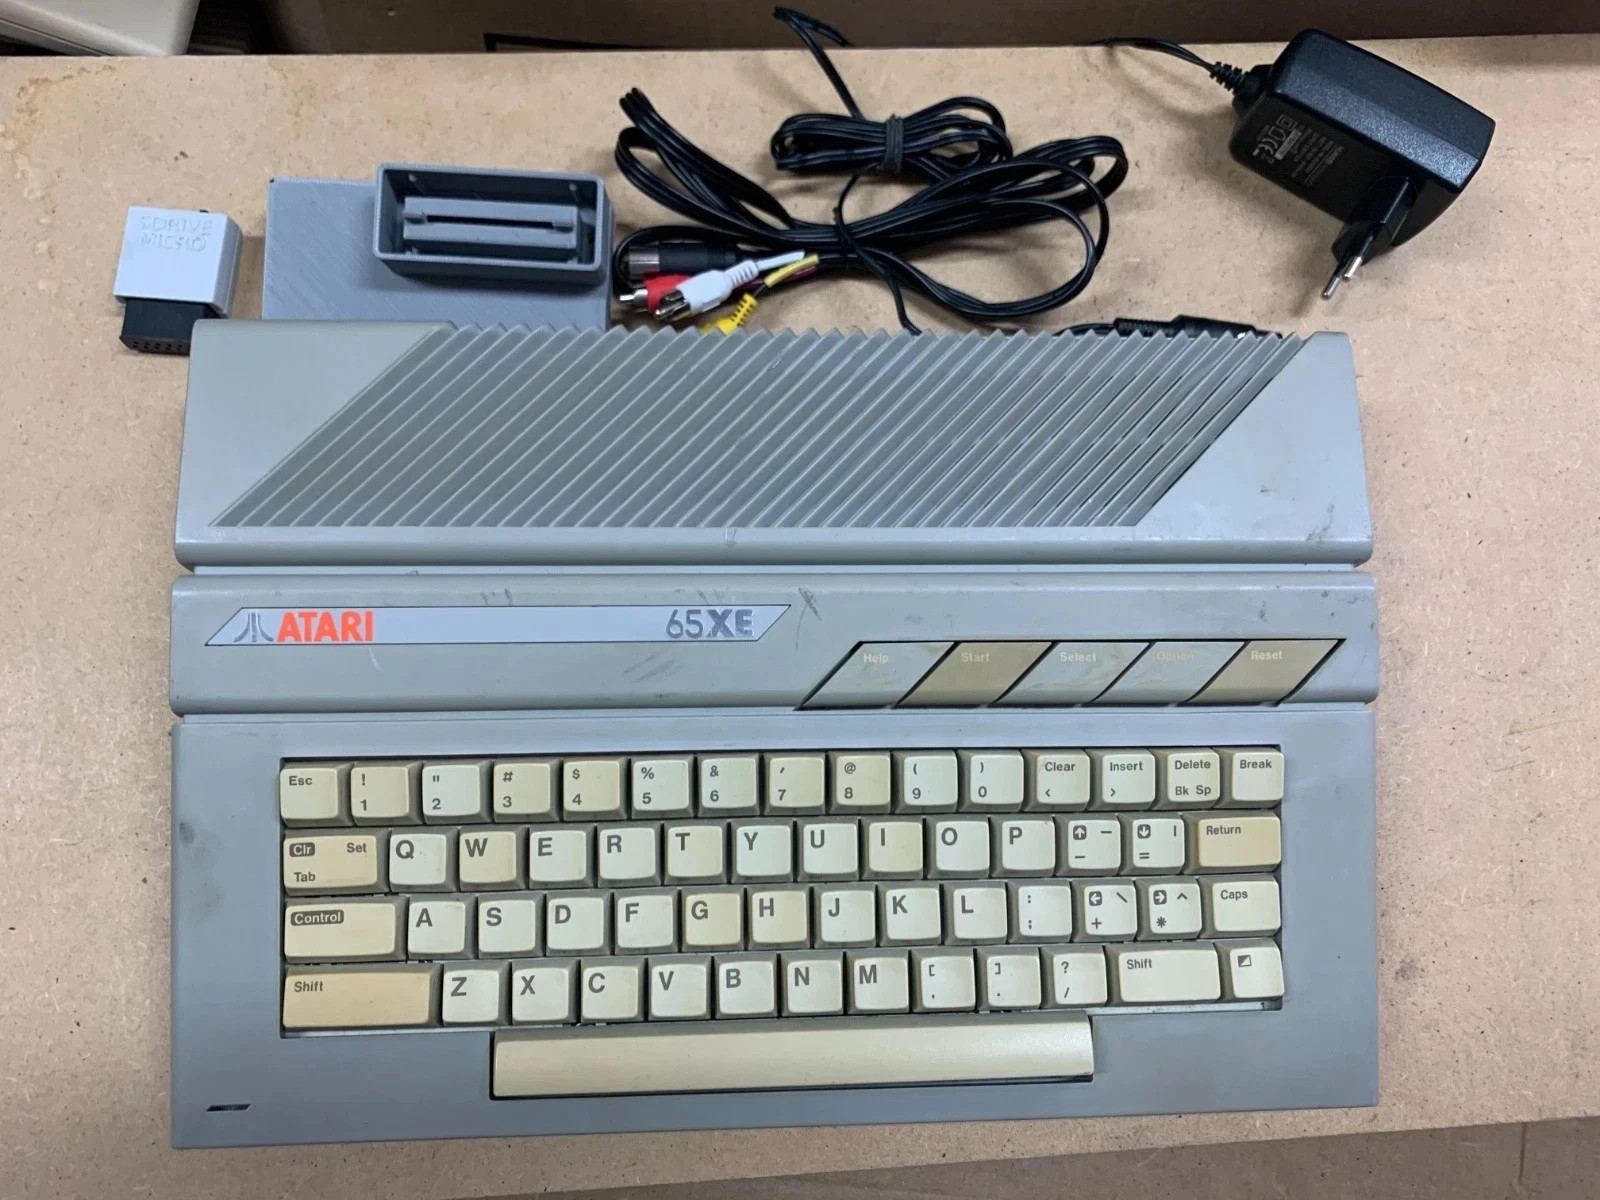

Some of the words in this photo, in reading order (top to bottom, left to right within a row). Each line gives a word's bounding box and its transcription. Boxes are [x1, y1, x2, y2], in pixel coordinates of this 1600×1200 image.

[276, 611, 373, 642] ATARI
[666, 609, 753, 639] 65XE
[864, 653, 889, 664] Help
[961, 652, 990, 662] Start
[1060, 652, 1096, 662] Select
[1251, 650, 1282, 660] Reset
[844, 762, 856, 774] @
[1045, 762, 1075, 771] Clear
[1110, 761, 1143, 771] Insert
[1175, 760, 1211, 769] Delete
[1240, 759, 1272, 769] Break
[503, 772, 513, 782] #
[573, 769, 580, 780] $
[641, 767, 654, 779] %
[710, 765, 718, 777] &
[289, 776, 312, 785] Esc
[361, 773, 366, 786] !
[710, 790, 719, 802] 6
[778, 789, 786, 800] 7
[844, 787, 853, 799] 8
[912, 788, 921, 799] 9
[1176, 786, 1188, 795] Bk
[1196, 785, 1211, 796] Sp
[432, 798, 441, 810] 2
[503, 796, 512, 807] 3
[573, 794, 582, 805] 4
[643, 792, 651, 804] 5
[361, 799, 366, 811] 1
[1010, 827, 1022, 844] P
[1207, 825, 1241, 835] Return
[675, 833, 690, 850] T
[744, 832, 758, 850] Y
[811, 830, 824, 848] U
[880, 827, 886, 847] I
[941, 827, 957, 846] O
[293, 844, 312, 855] Clr
[347, 843, 366, 853] Set
[396, 840, 414, 859] Q
[465, 838, 488, 857] W
[538, 837, 552, 856] E
[607, 835, 621, 853] R
[294, 872, 315, 882] Tab
[1221, 890, 1247, 900] Caps
[759, 898, 774, 917] H
[828, 898, 839, 917] J
[893, 895, 908, 914] K
[961, 895, 974, 913] L
[486, 907, 502, 926] S
[555, 905, 571, 924] D
[626, 903, 639, 922] F
[691, 901, 708, 920] G
[294, 912, 341, 923] Control
[416, 908, 432, 927] A
[1092, 918, 1101, 929] +
[1061, 961, 1069, 973] ?
[1127, 959, 1152, 969] Shift
[726, 969, 741, 988] B
[795, 967, 809, 986] N
[859, 964, 877, 984] M
[295, 981, 323, 992] Shift
[451, 977, 467, 996] Z
[520, 975, 535, 995] X
[589, 973, 605, 993] C
[659, 971, 674, 990] V
